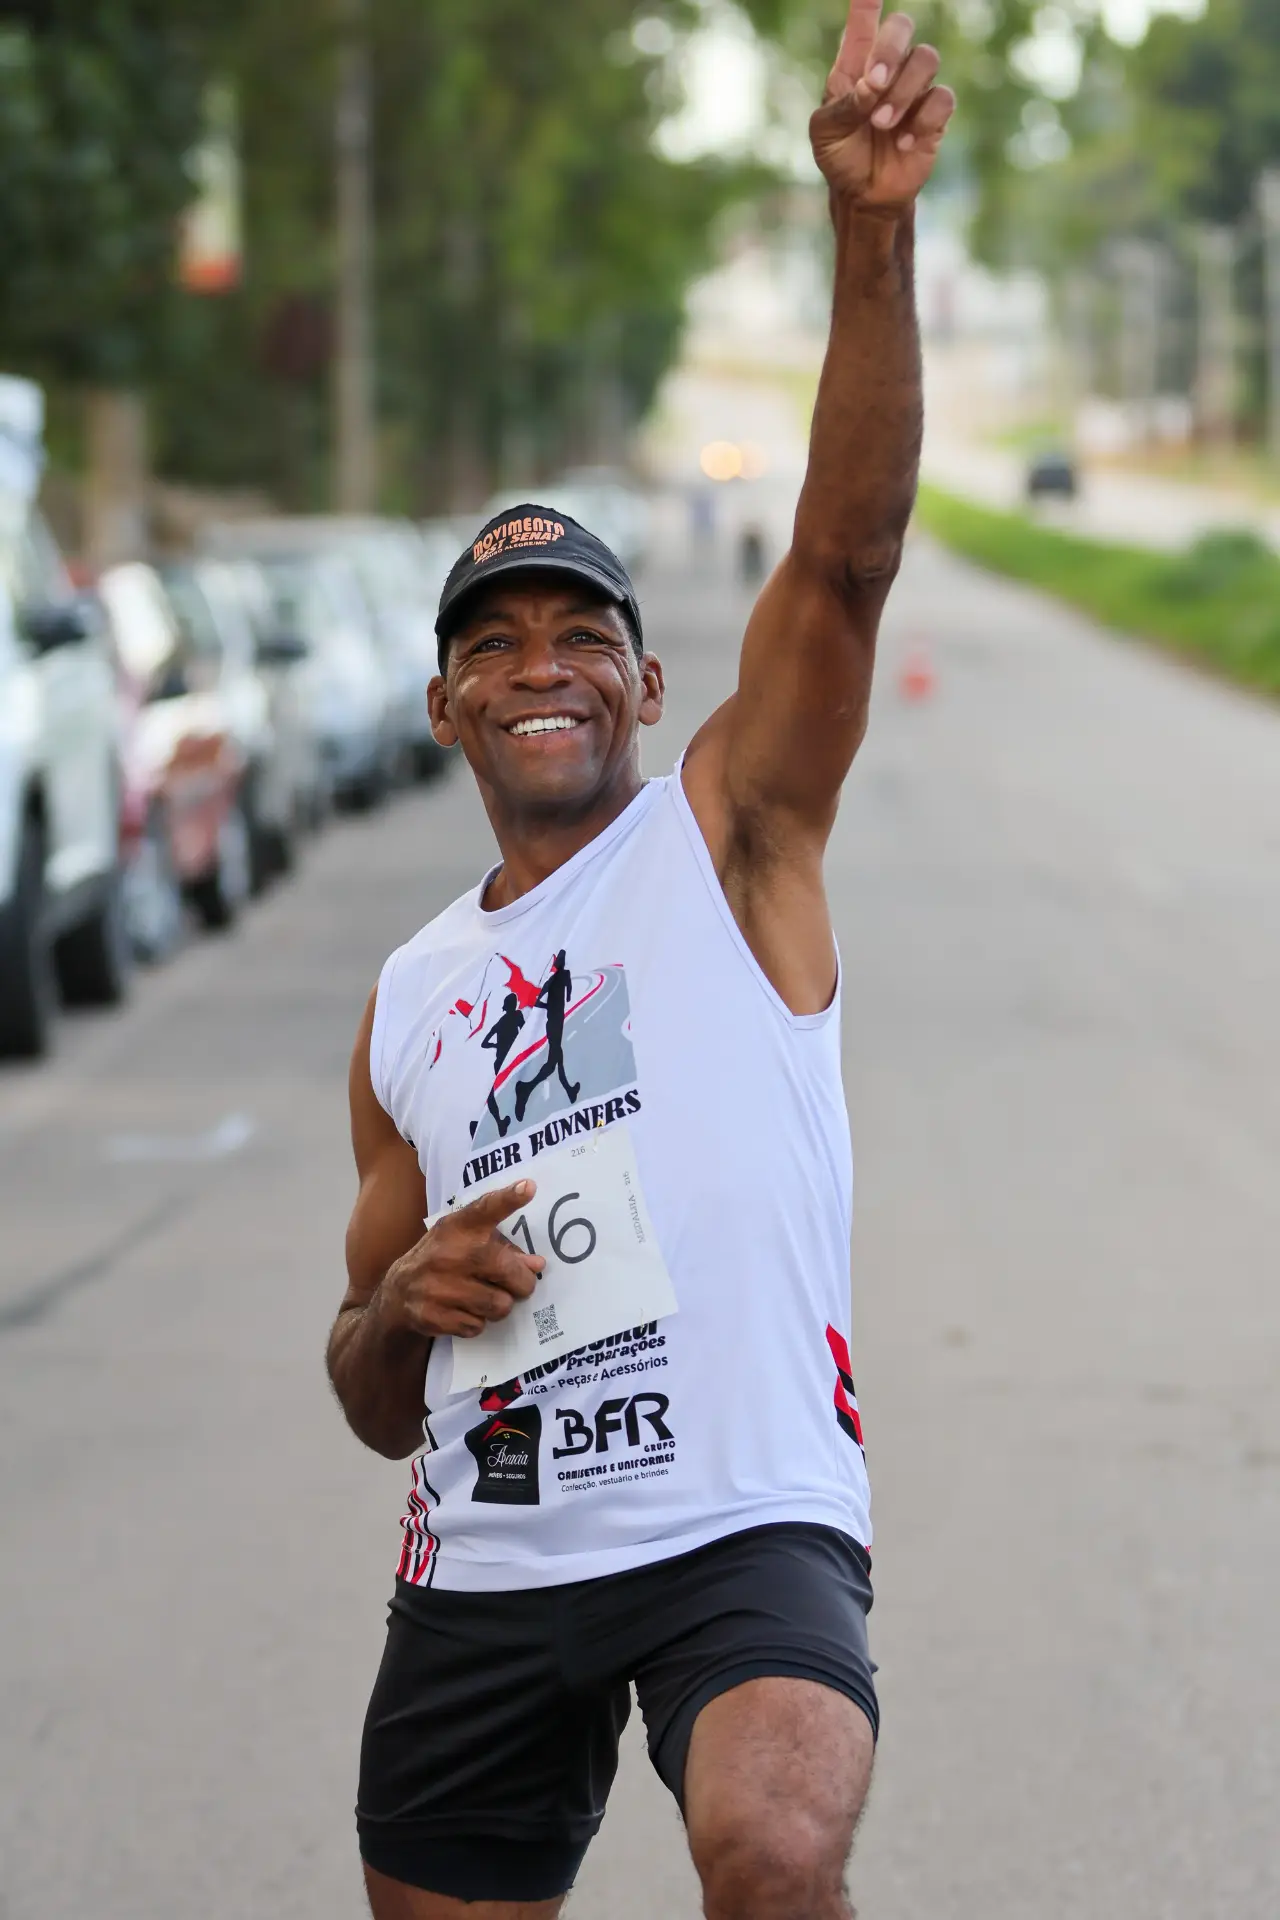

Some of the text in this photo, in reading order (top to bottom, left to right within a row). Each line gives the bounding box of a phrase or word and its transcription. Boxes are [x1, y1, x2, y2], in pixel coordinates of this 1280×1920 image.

[473, 517, 565, 560] MOVIMENTA
[475, 531, 561, 565] SEST SENAT
[504, 540, 548, 551] ALEGRE/MG
[528, 1088, 642, 1158] RUNNERS
[570, 1146, 586, 1158] 216
[557, 1373, 592, 1389] Peças
[600, 1356, 669, 1381] Acessórios
[552, 1392, 675, 1460] BFR
[643, 1440, 676, 1453] GRUPO
[557, 1453, 675, 1482] CAMISETAS E UNIFORMES
[598, 1474, 633, 1486] vestuário
[640, 1468, 669, 1480] brindes
